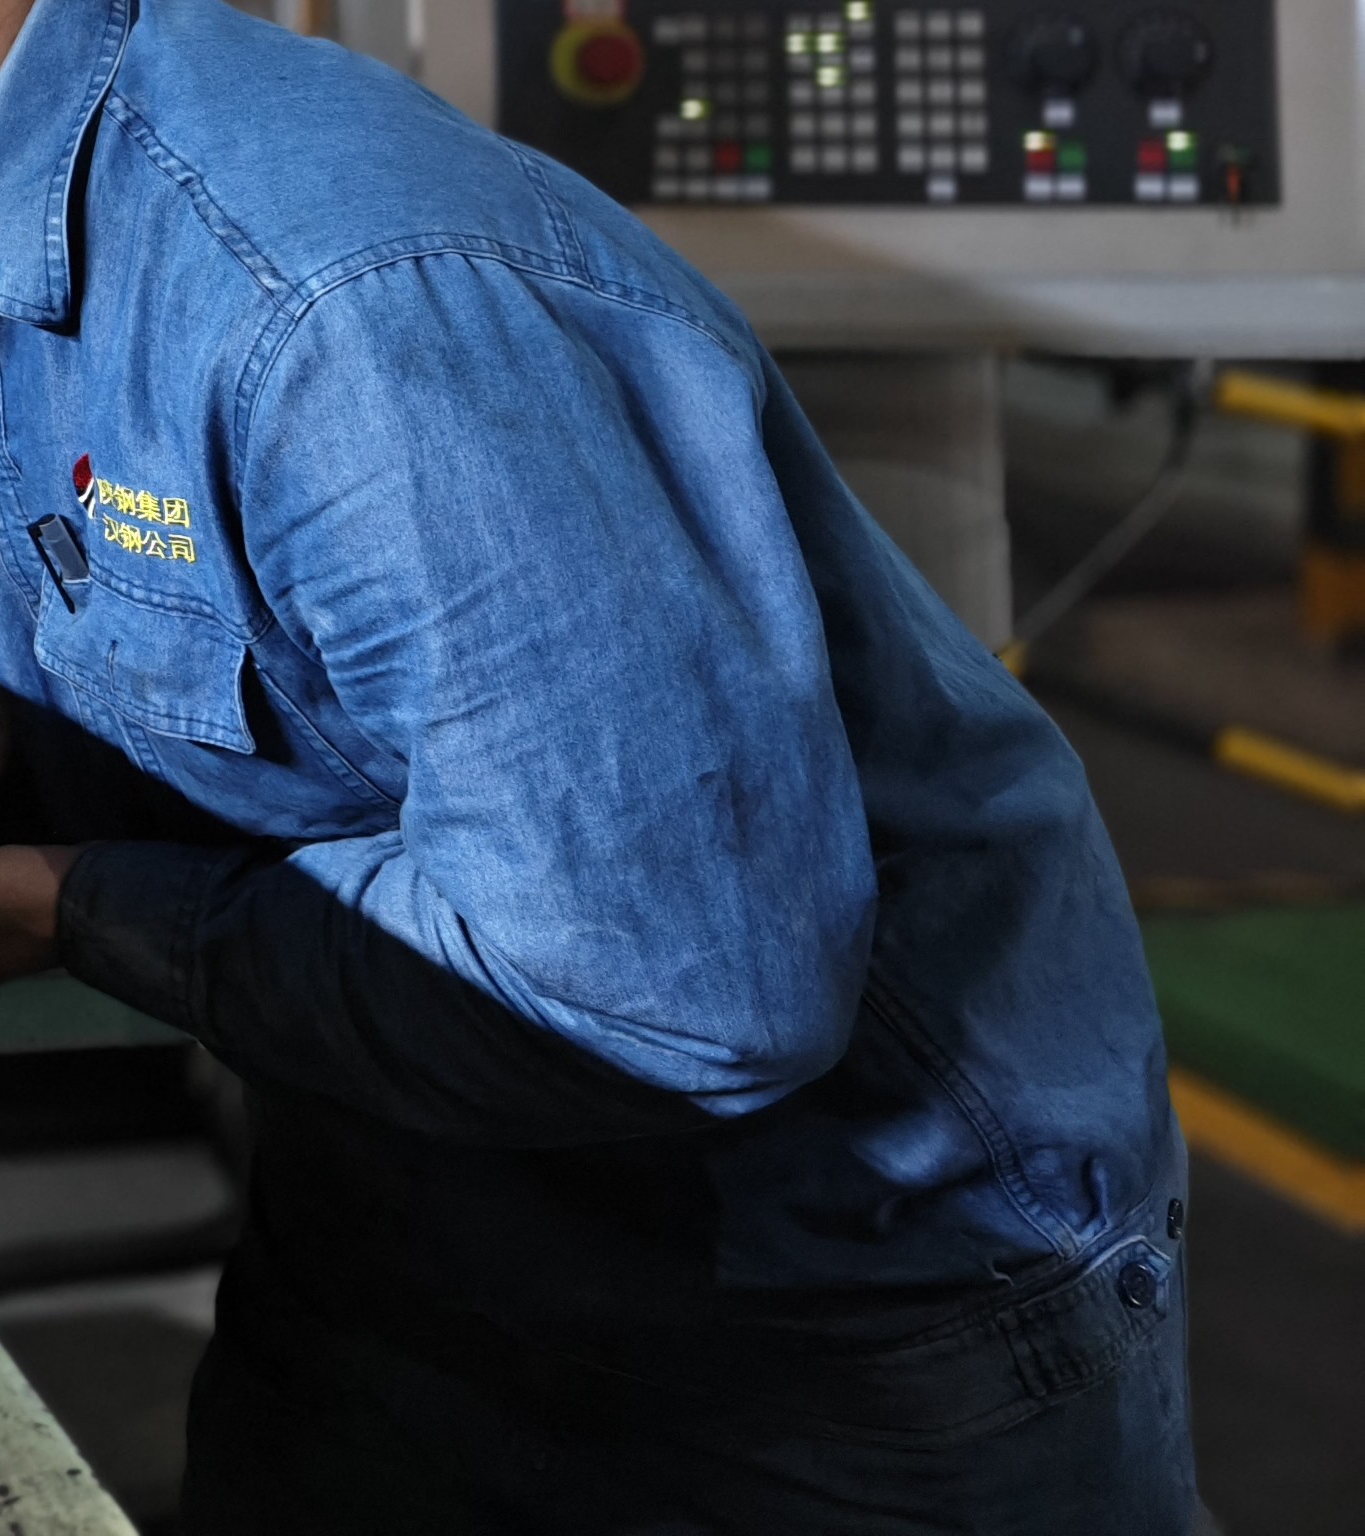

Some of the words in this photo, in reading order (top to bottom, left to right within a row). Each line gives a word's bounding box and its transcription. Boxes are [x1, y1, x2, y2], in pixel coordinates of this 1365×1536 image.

[97, 478, 190, 528] 陕钢集团
[102, 512, 196, 563] 汉钢公司
